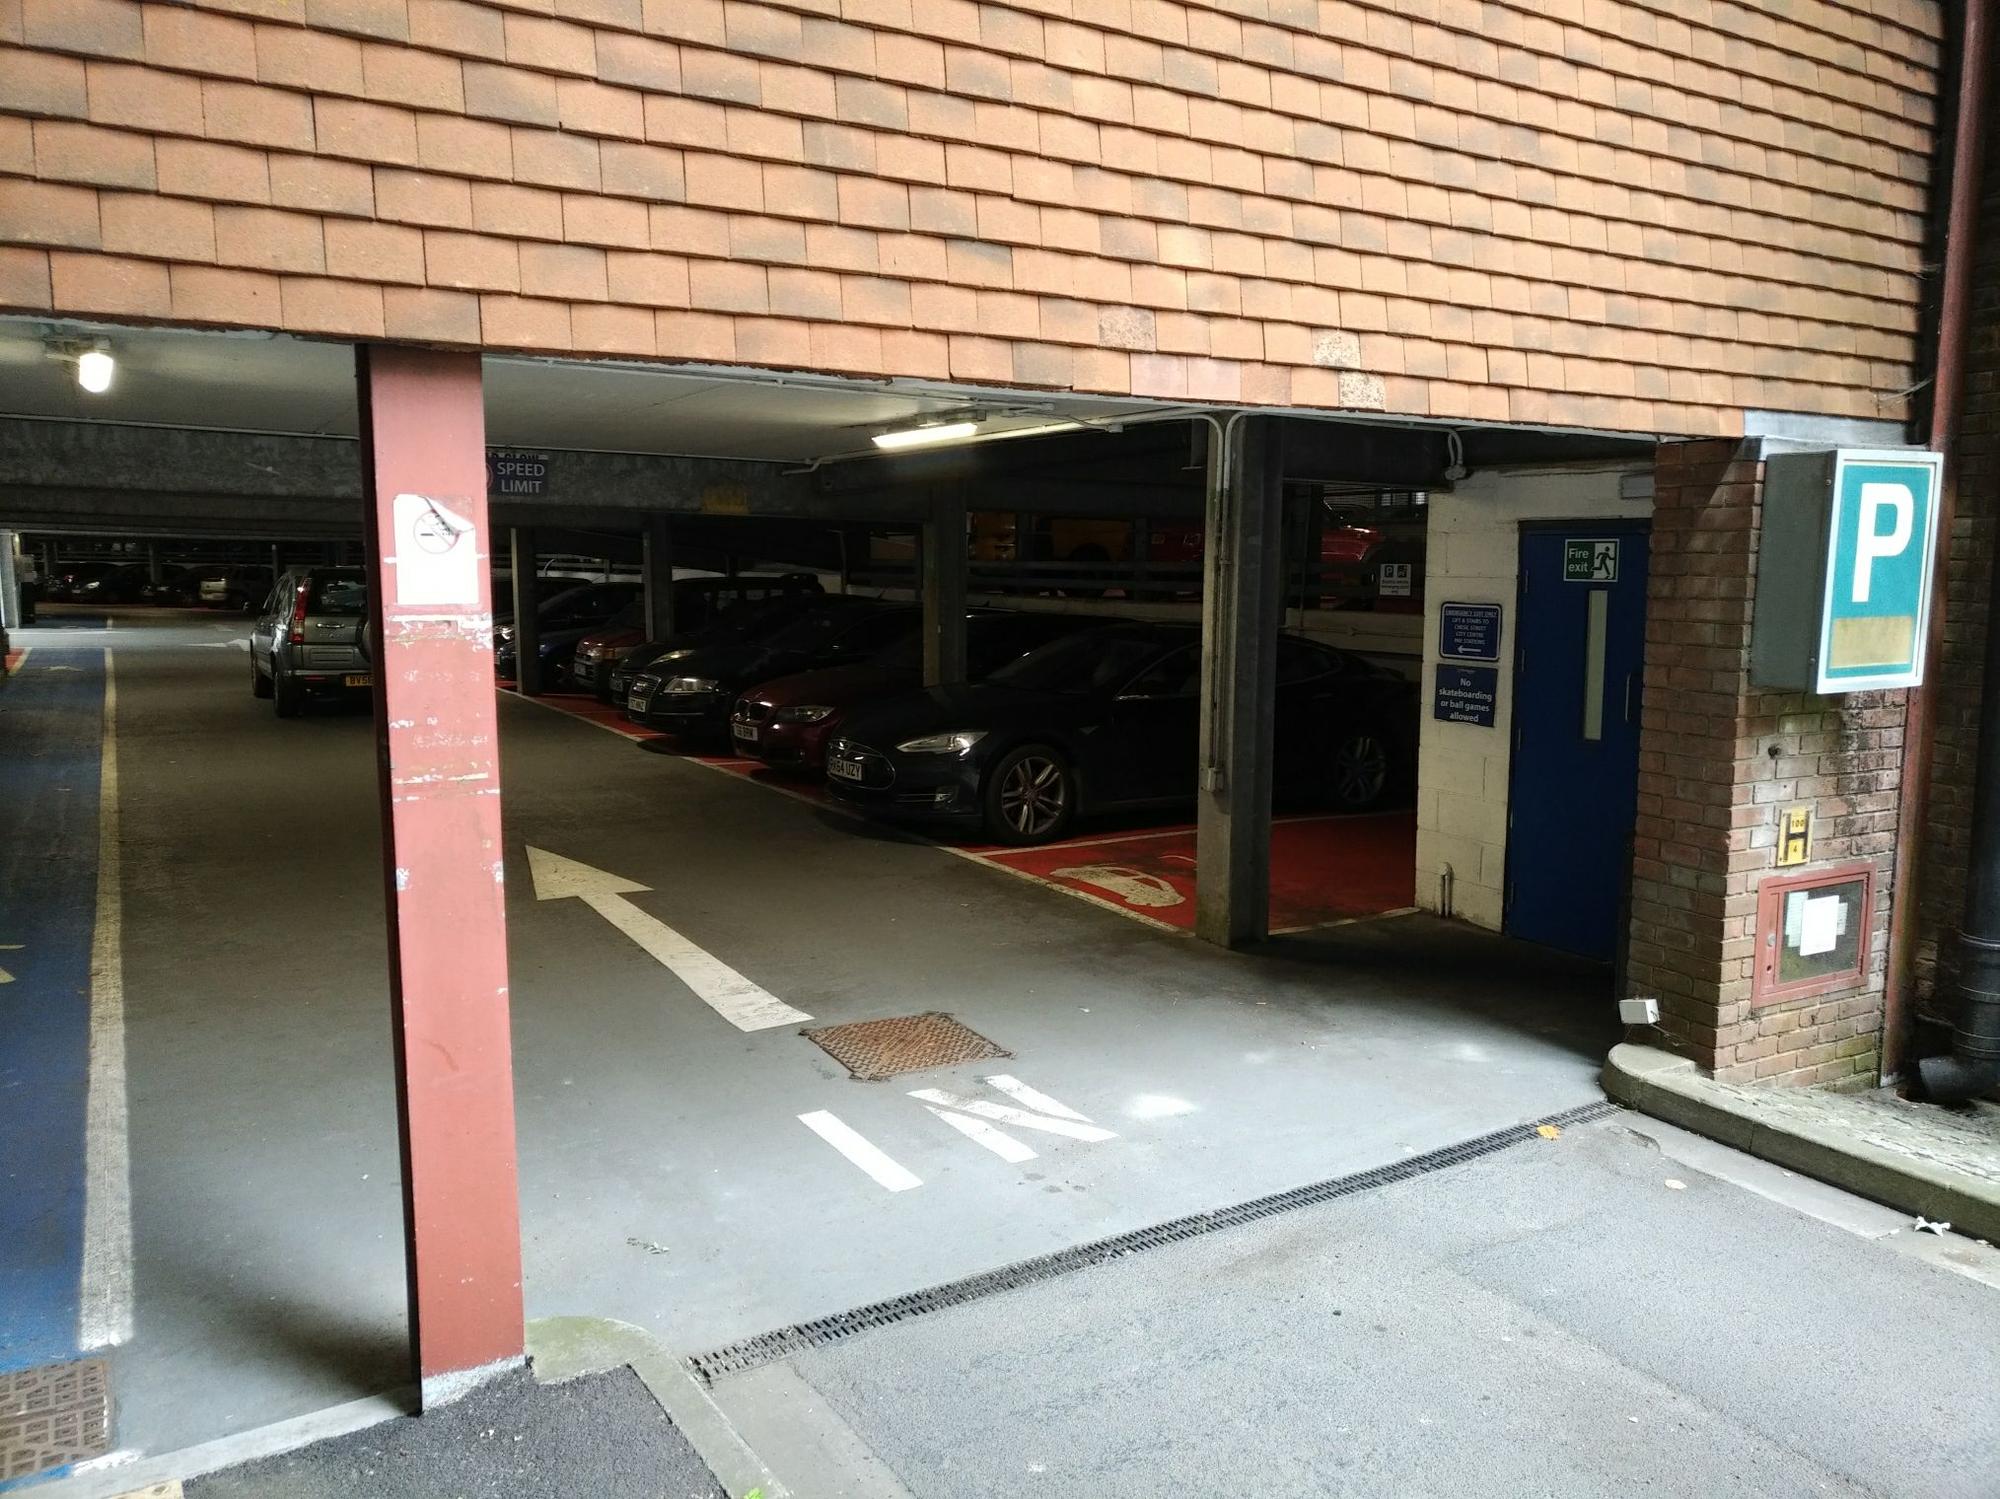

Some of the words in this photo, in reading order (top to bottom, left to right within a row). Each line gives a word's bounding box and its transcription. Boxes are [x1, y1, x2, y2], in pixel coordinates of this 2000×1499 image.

[496, 462, 545, 477] SPEED
[501, 479, 543, 493] LIMIT
[1850, 481, 1915, 604] P
[1568, 547, 1589, 559] Fire
[1568, 562, 1588, 572] exit
[1460, 677, 1472, 687] No
[1439, 688, 1492, 702] skateboarding
[1449, 699, 1464, 709] ball
[1465, 703, 1490, 712] games
[1449, 711, 1479, 723] allowed
[845, 761, 861, 778] UZY
[1791, 819, 1805, 828] 100
[795, 1073, 1120, 1192] IN
